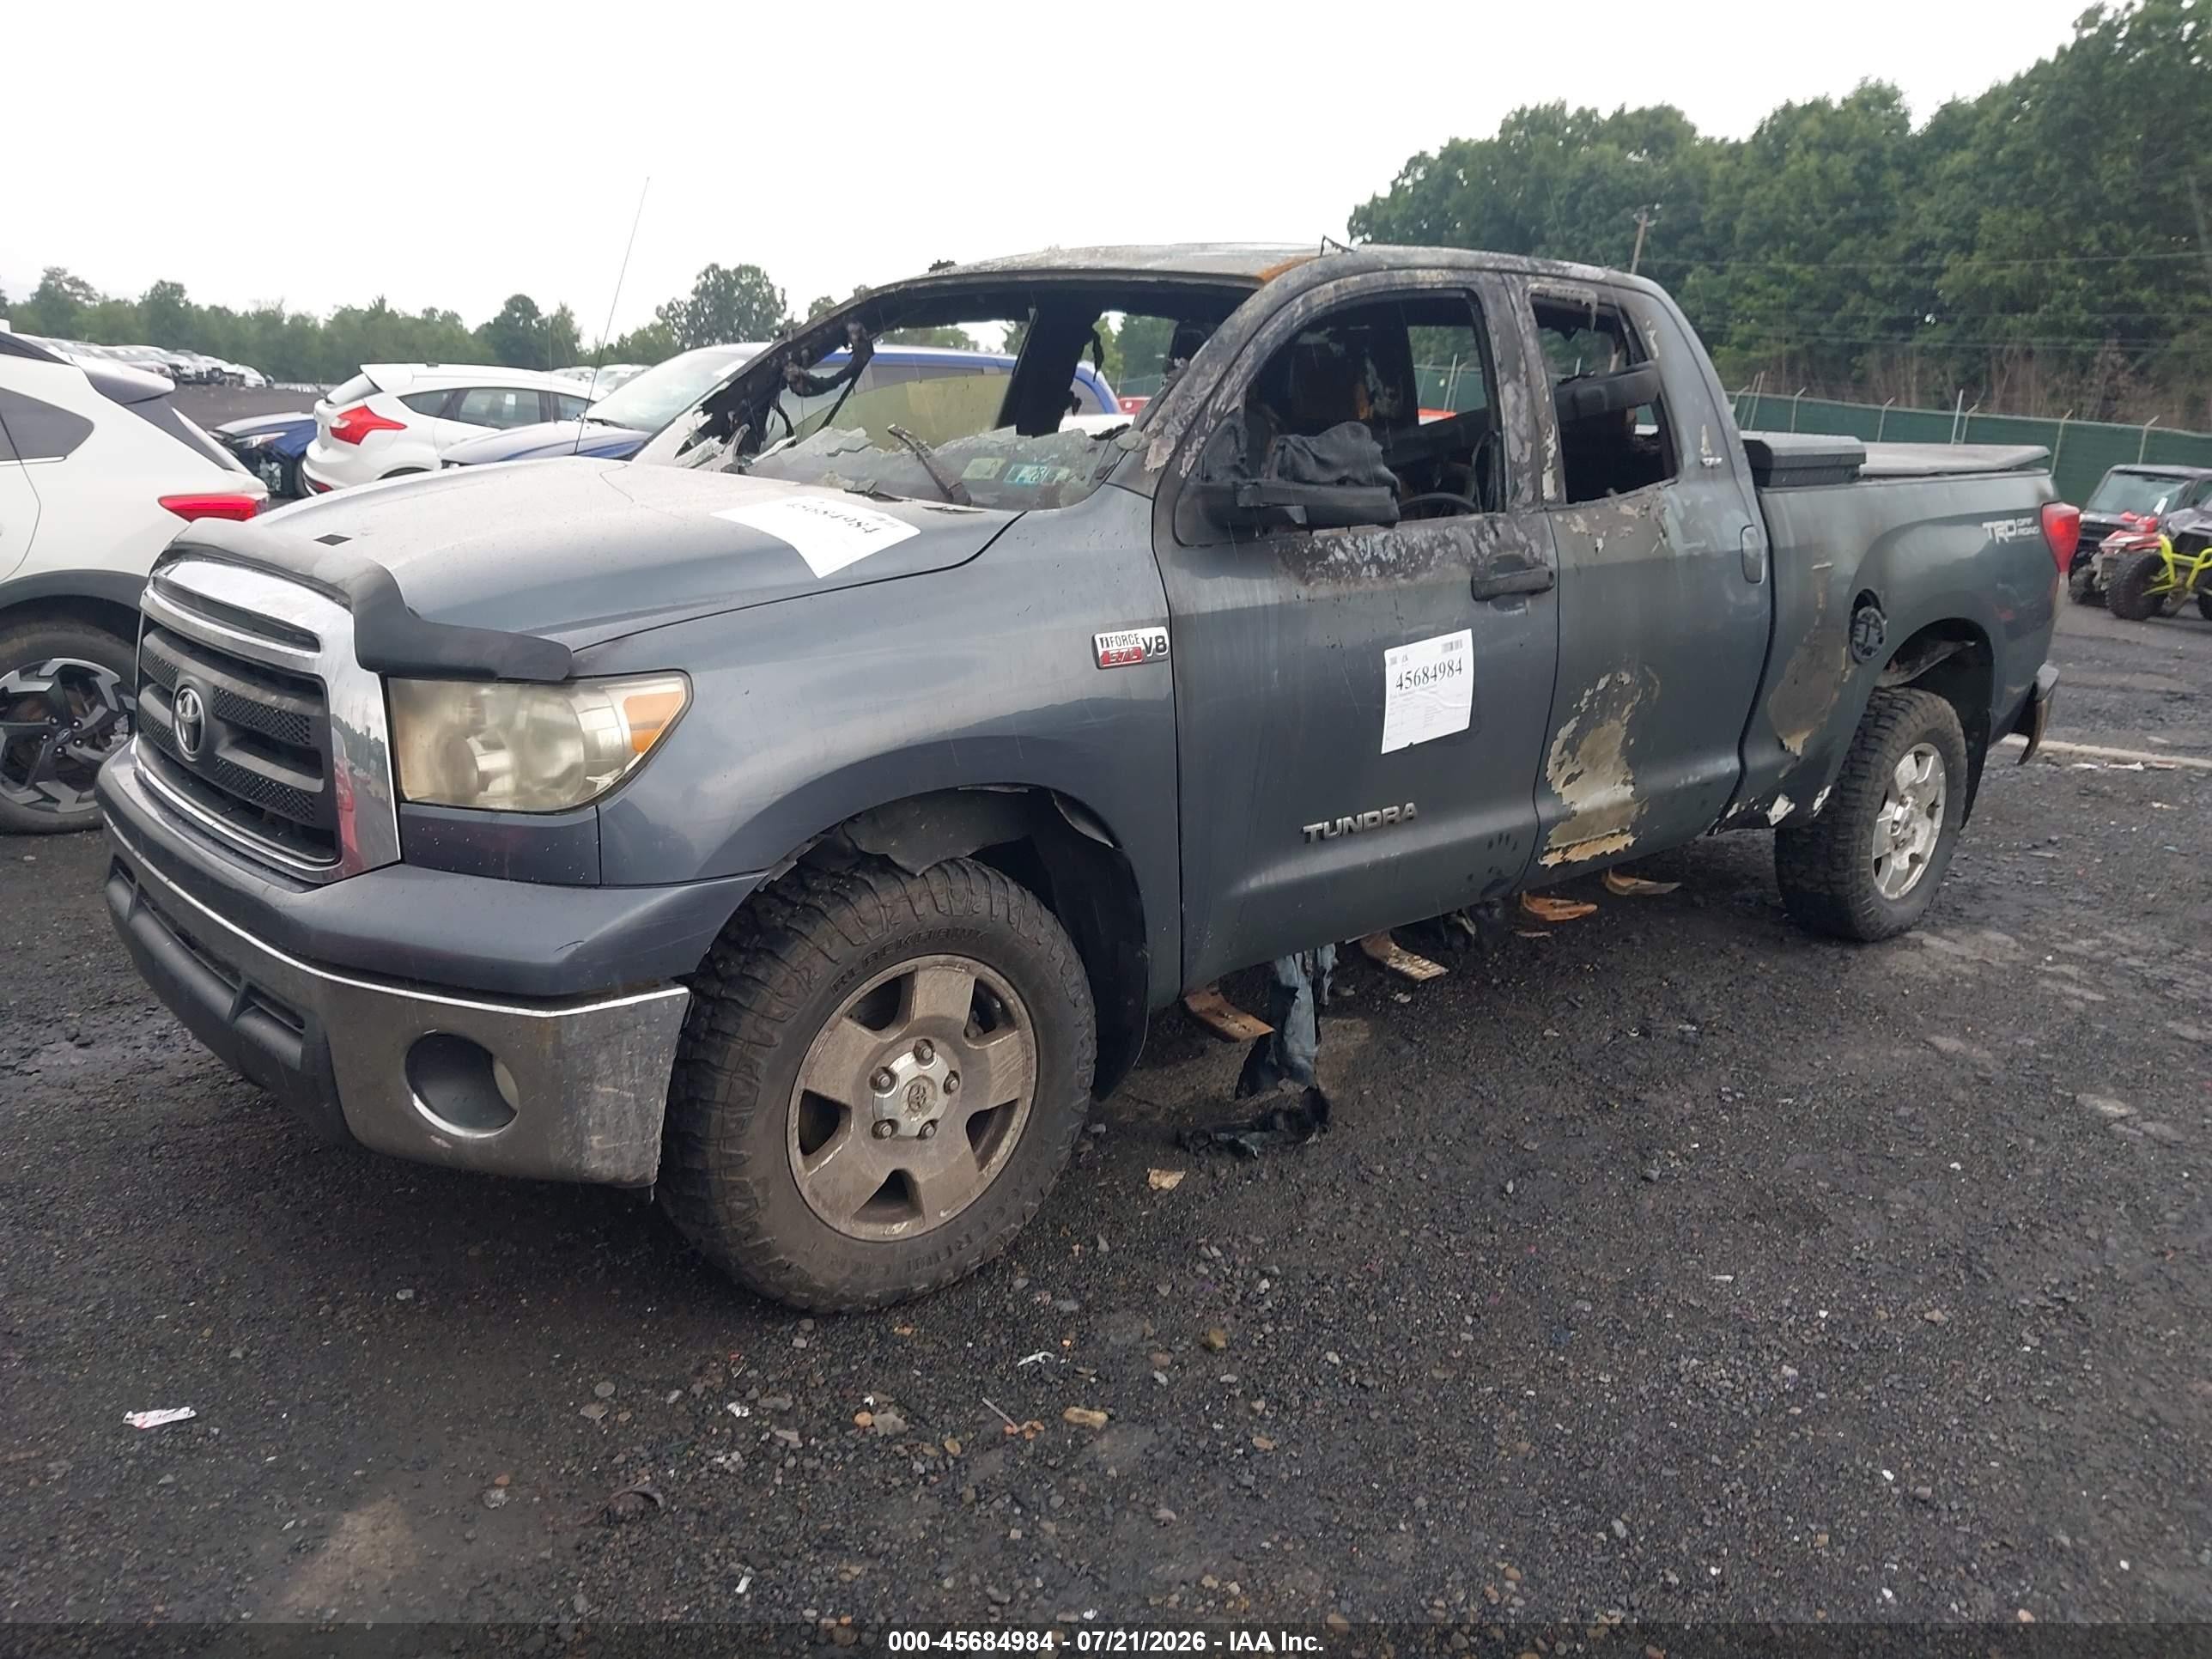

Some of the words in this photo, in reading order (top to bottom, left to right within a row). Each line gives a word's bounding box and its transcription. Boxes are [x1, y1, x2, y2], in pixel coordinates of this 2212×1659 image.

[1982, 519, 2017, 544] TRD
[1141, 635, 1167, 657] V8
[1395, 657, 1462, 691] 45684984
[1303, 802, 1418, 844] TUNDRA
